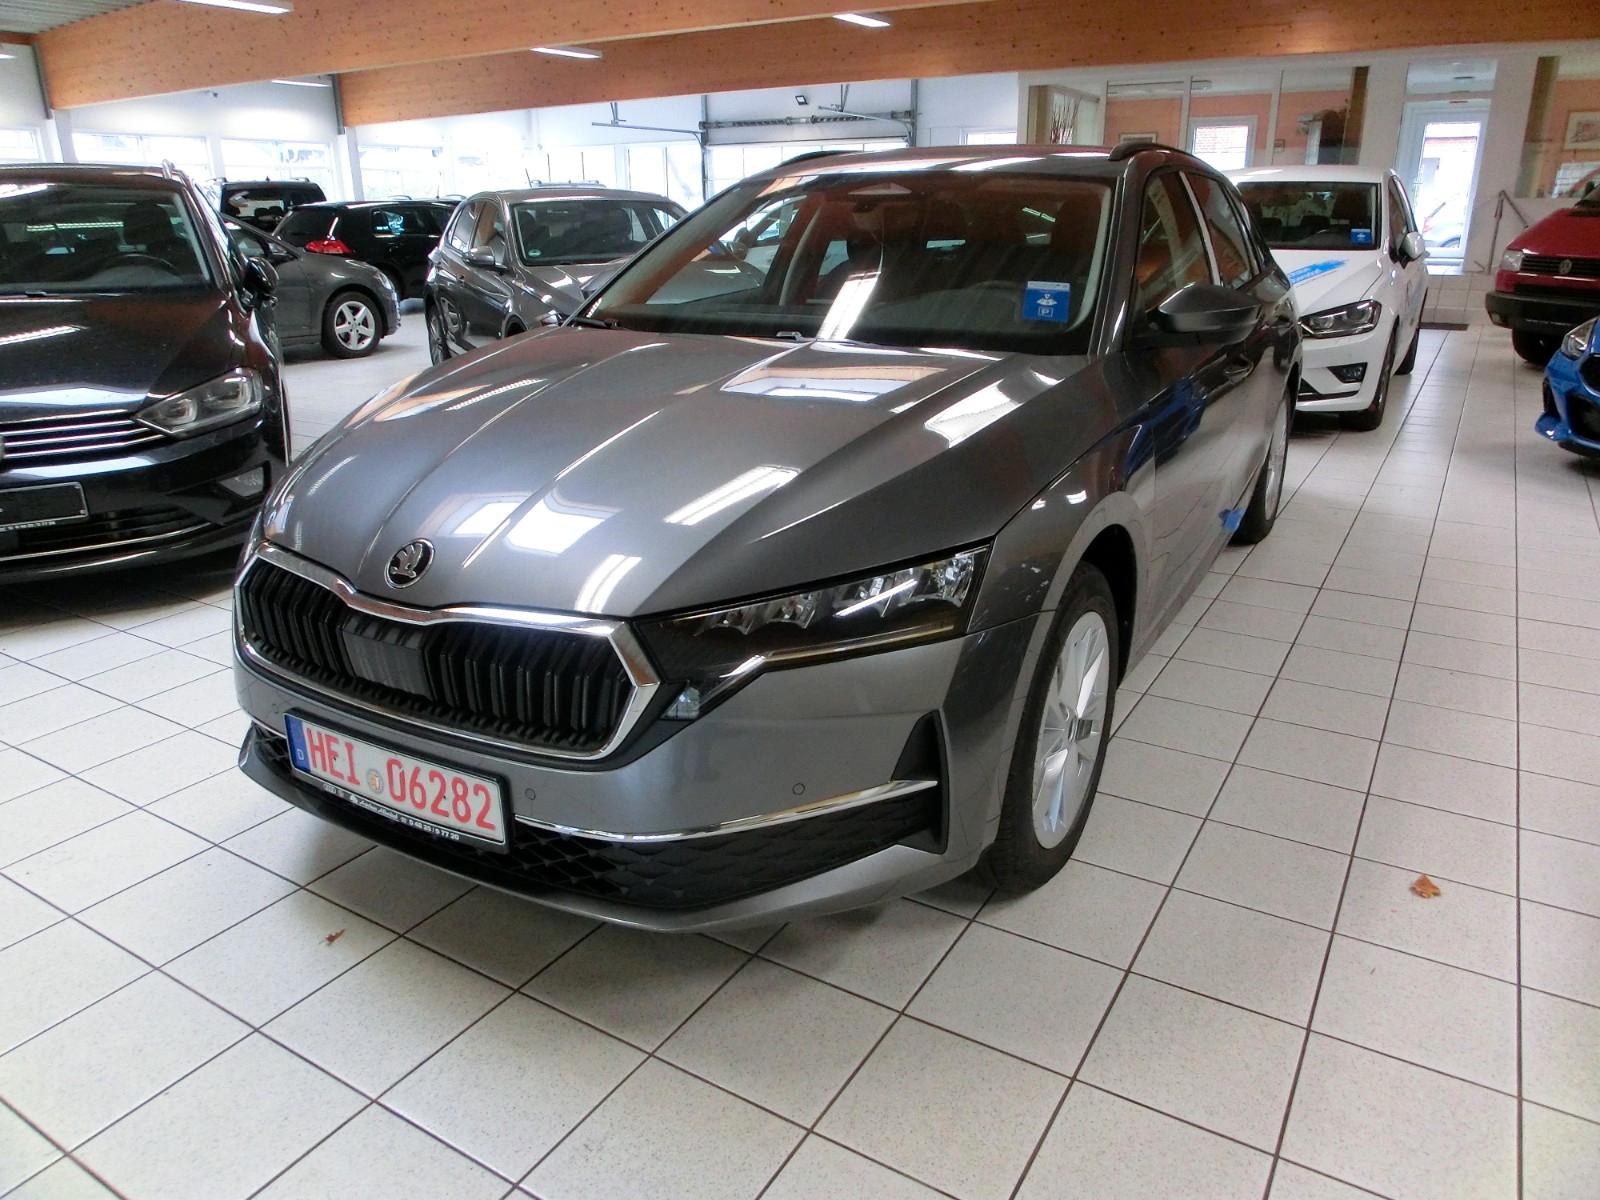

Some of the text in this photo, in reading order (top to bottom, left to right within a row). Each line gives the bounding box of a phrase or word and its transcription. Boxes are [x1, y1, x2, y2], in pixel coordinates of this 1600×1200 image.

[296, 748, 304, 760] D
[306, 727, 497, 831] HEI 06282
